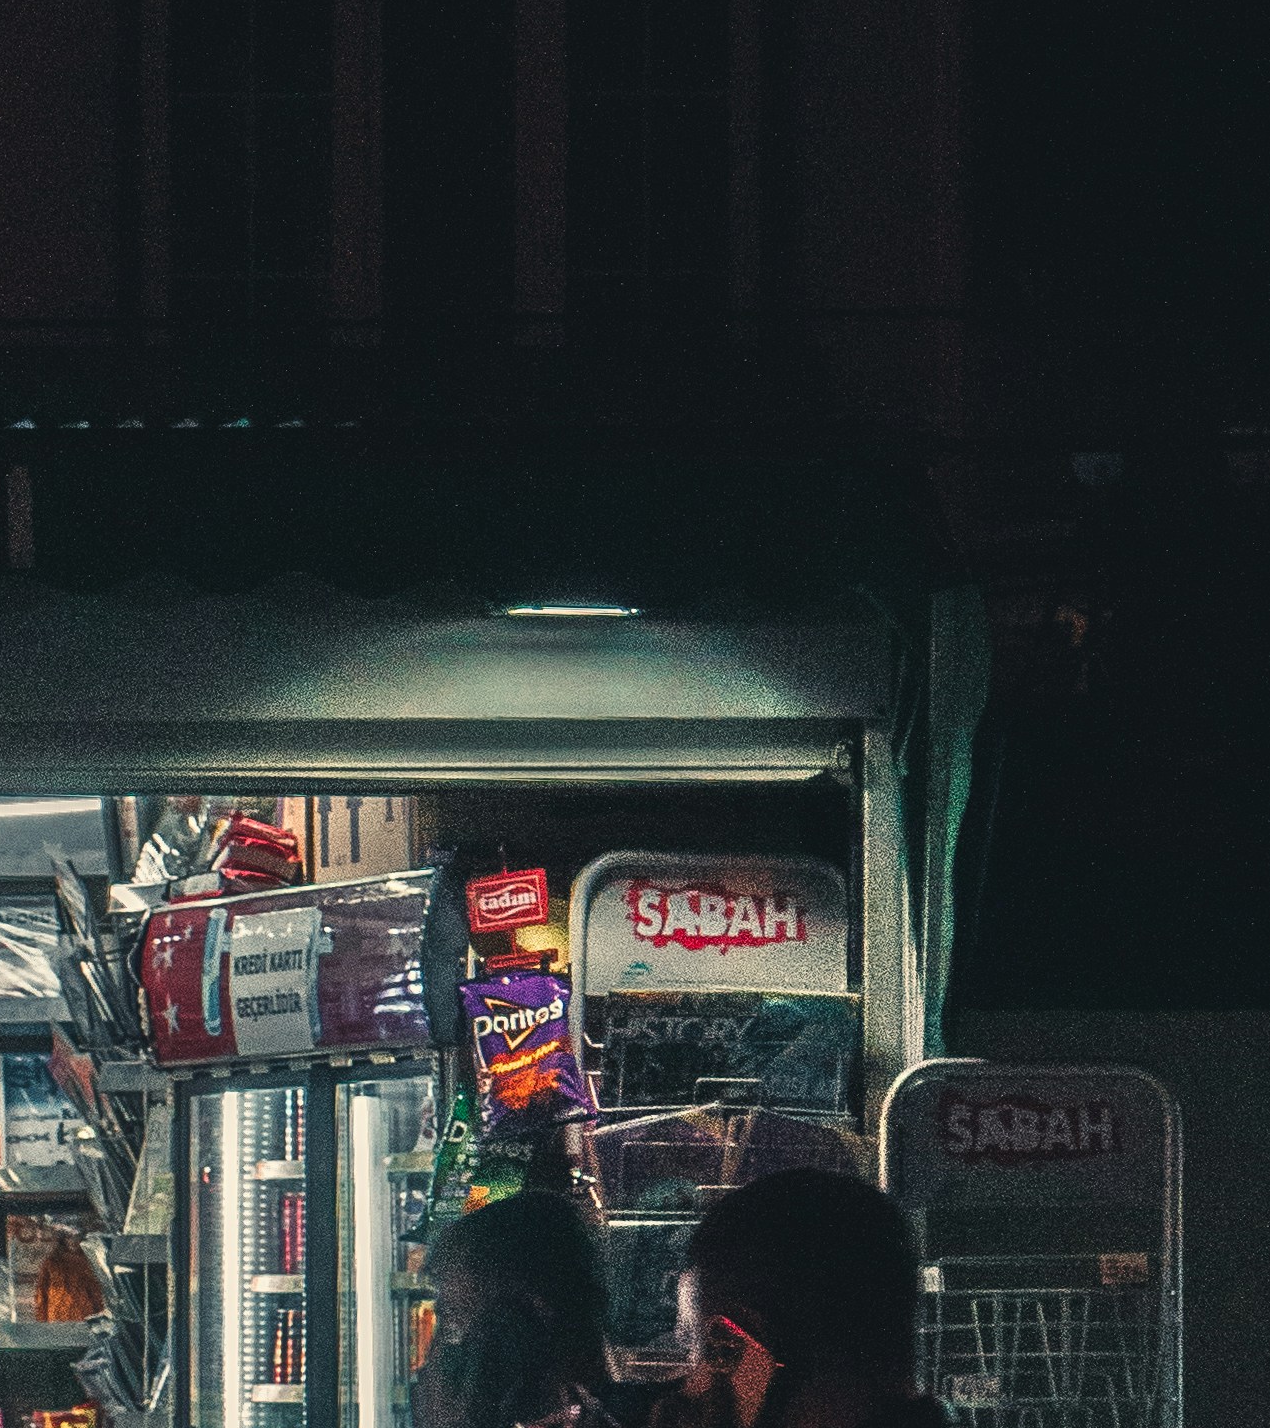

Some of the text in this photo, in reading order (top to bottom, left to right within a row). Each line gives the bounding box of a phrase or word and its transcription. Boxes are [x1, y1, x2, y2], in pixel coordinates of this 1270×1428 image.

[635, 886, 800, 940] SABAH
[234, 948, 267, 977] KREDİ
[473, 998, 564, 1038] Doritos
[946, 1103, 1113, 1154] SABAH
